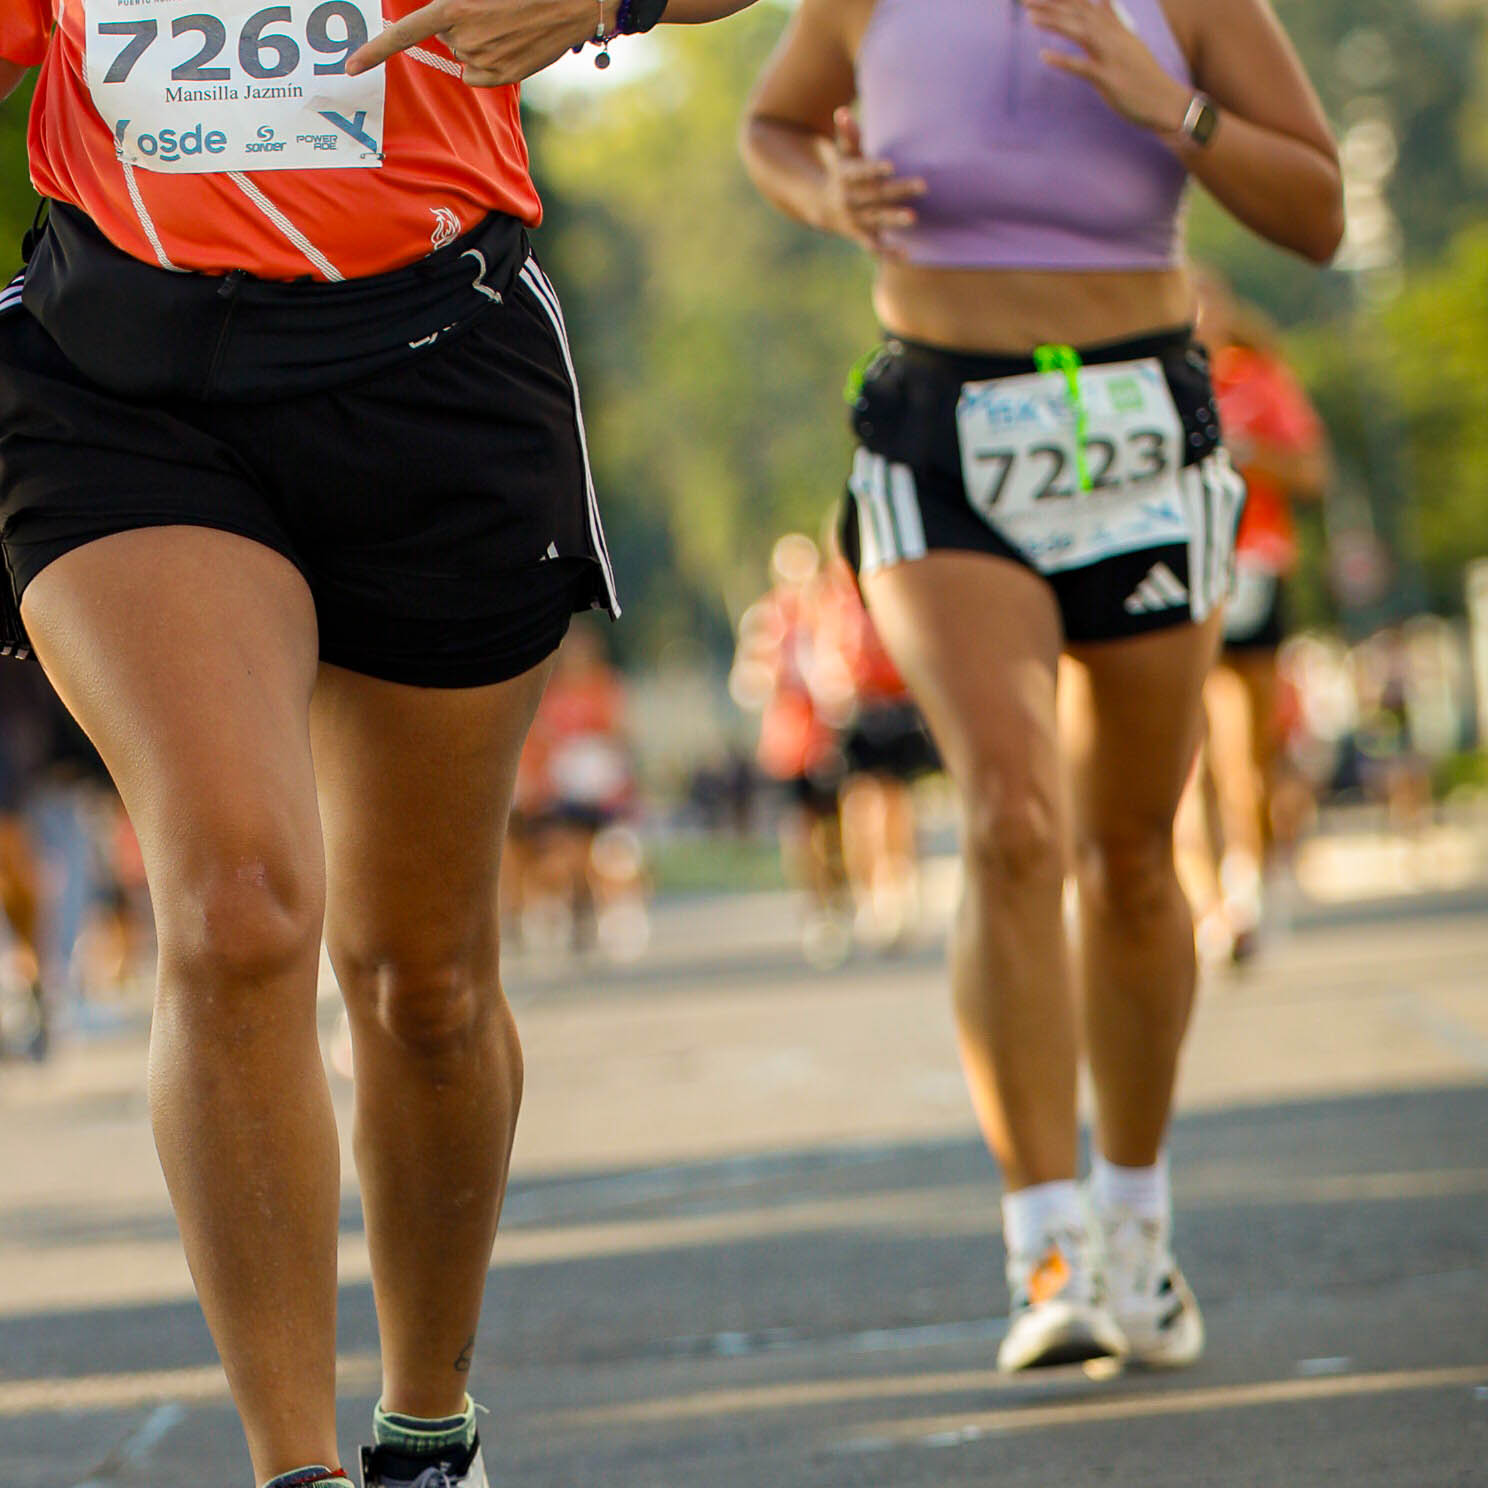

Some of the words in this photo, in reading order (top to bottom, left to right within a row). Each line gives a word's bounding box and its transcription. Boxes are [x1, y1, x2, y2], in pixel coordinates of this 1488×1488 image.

[97, 0, 369, 84] 7269
[165, 84, 238, 103] Mansilla
[244, 83, 304, 100] Jazmín
[137, 123, 227, 159] osde
[296, 134, 338, 143] POWER
[975, 428, 1168, 511] 7223
